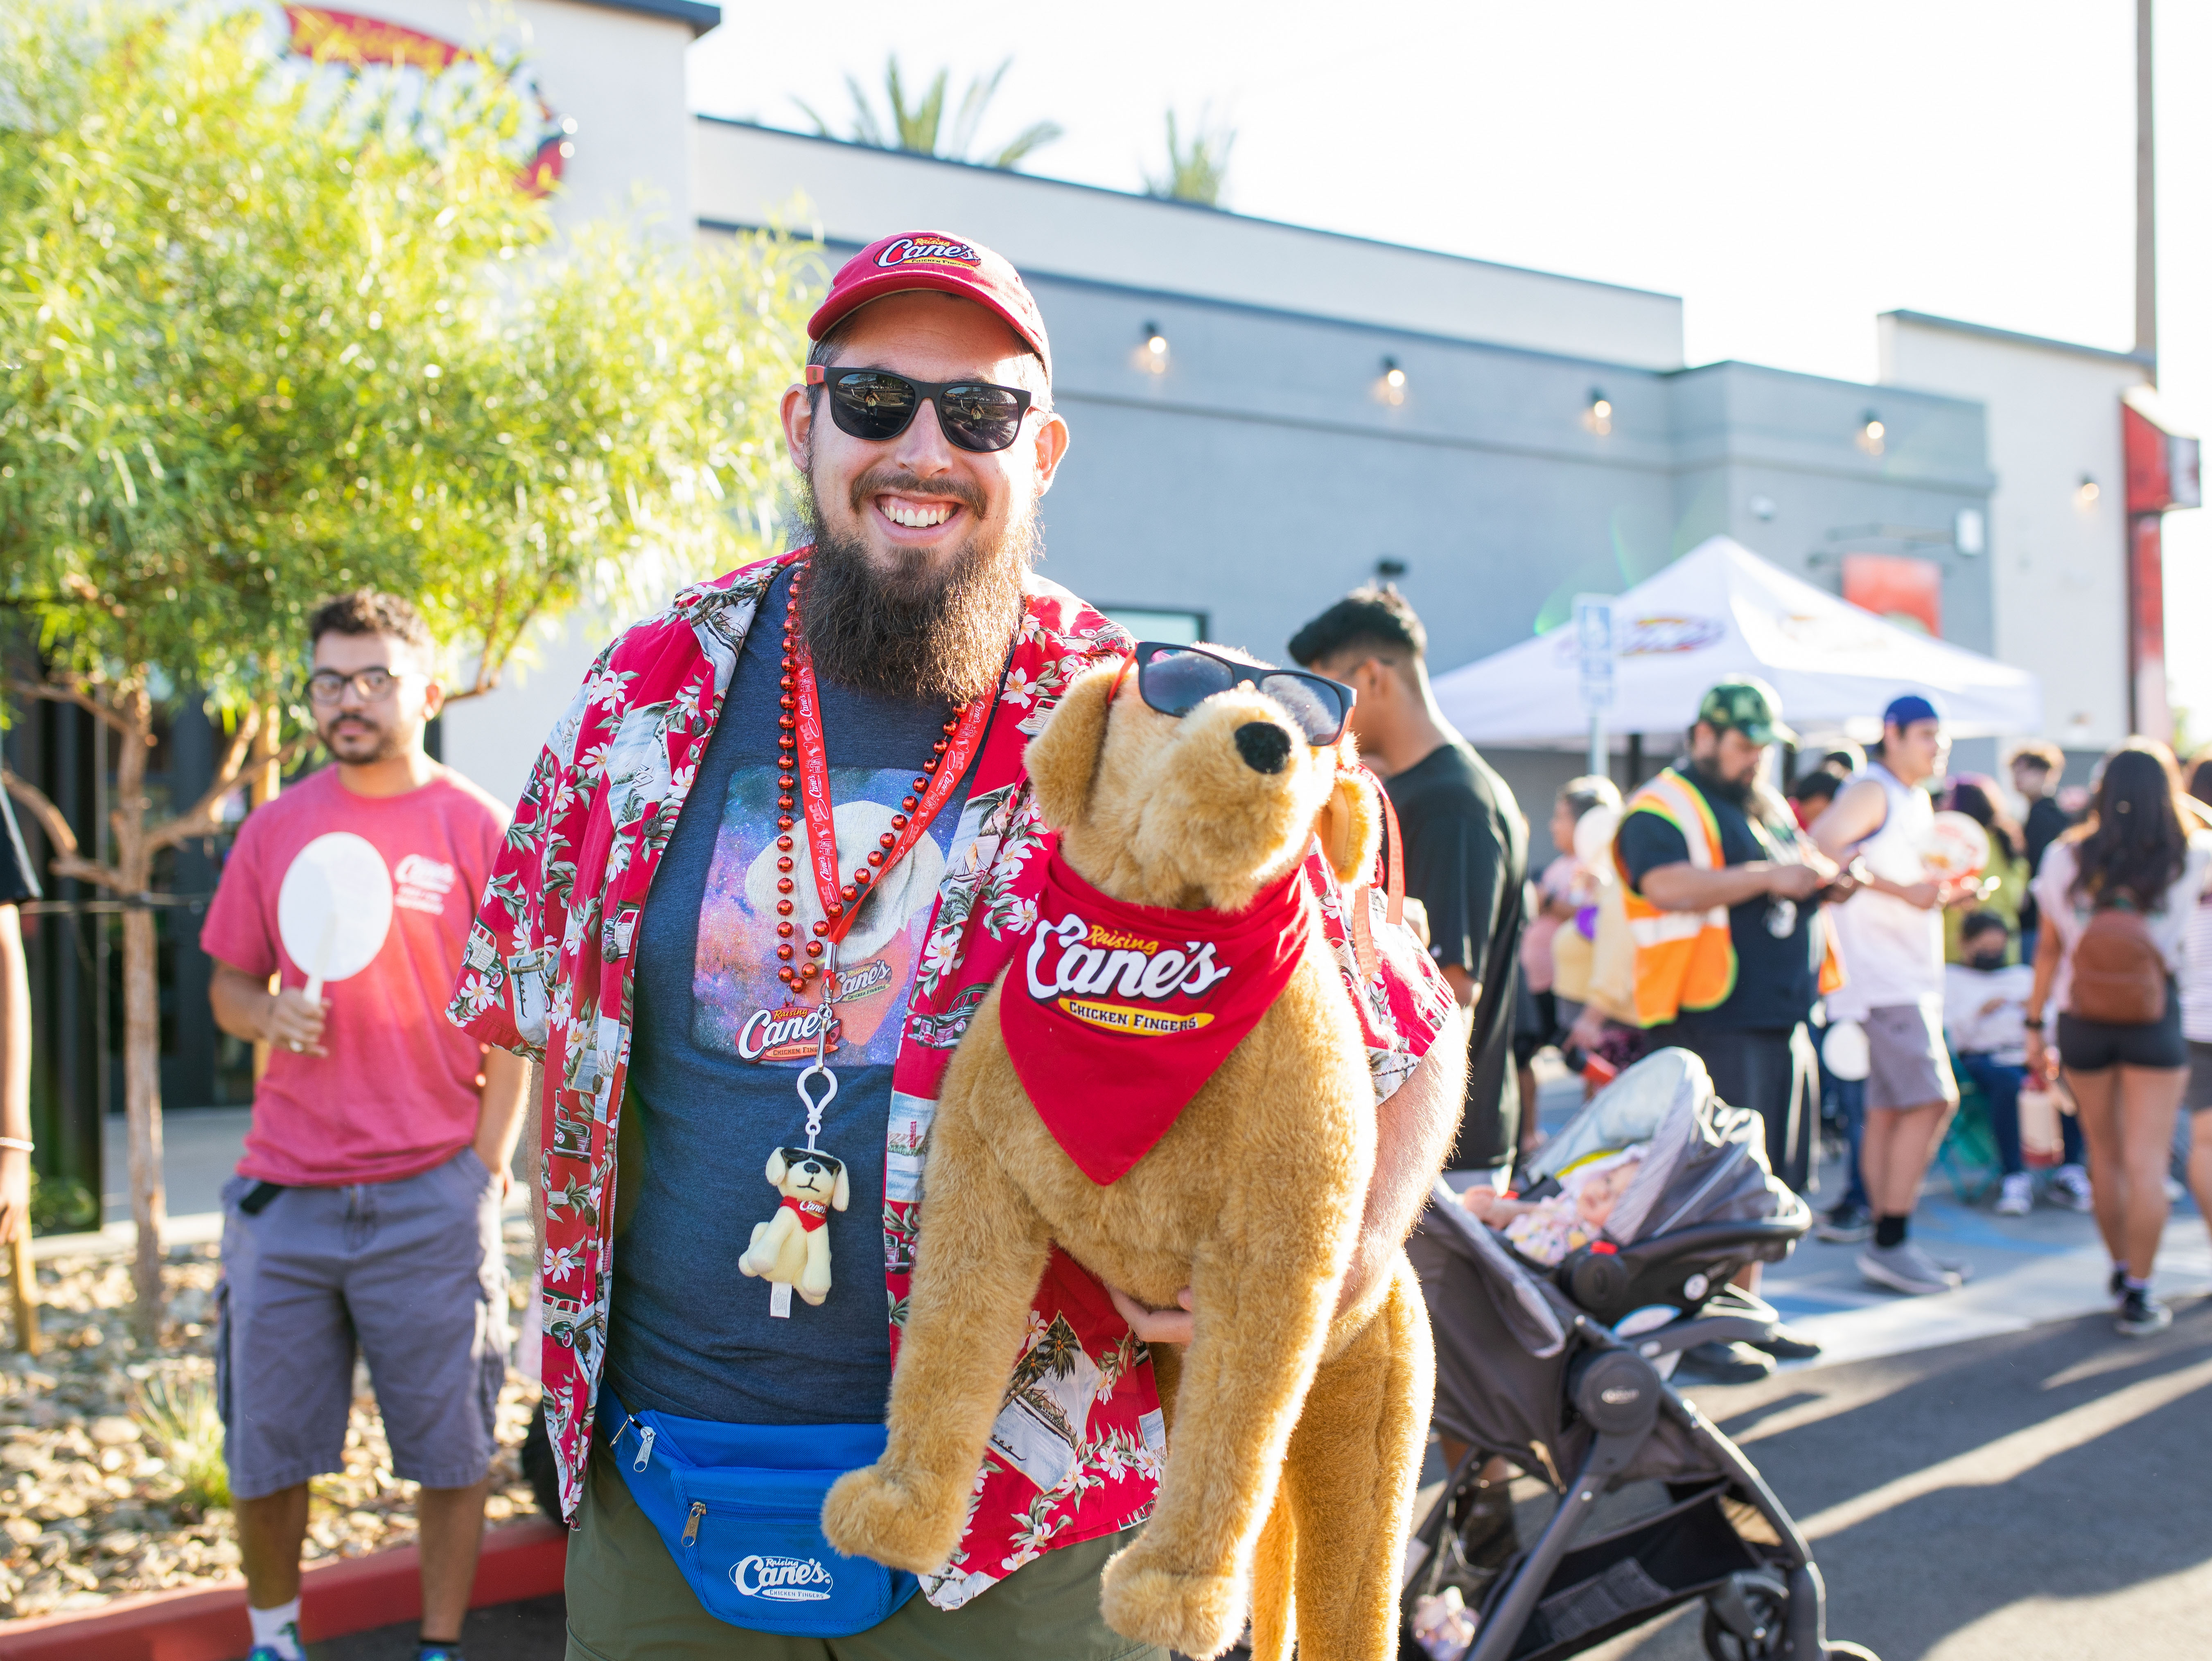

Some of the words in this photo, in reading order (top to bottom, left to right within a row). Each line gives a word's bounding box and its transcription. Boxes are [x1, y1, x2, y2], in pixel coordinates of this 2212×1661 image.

[878, 239, 980, 267] Cane's
[914, 238, 950, 247] Raising
[799, 695, 812, 717] Cane's
[808, 775, 822, 798] Cane's
[940, 771, 954, 796] Cane's
[818, 856, 832, 881] Cane's
[1083, 924, 1159, 956] Raising
[1354, 890, 1375, 969] RAISIN
[1027, 913, 1232, 999] Cane's
[822, 959, 891, 1004] Cane's
[847, 966, 871, 977] Raising
[773, 1008, 808, 1021] Raising
[1069, 1001, 1129, 1026] CHICKEN
[1133, 1014, 1199, 1032] FINGERS
[773, 1048, 801, 1056] CHICKEN
[802, 1045, 831, 1054] FINGS
[799, 1200, 826, 1214] Cane's
[765, 1558, 799, 1568] Raising
[735, 1555, 831, 1596] Cane's
[798, 1591, 824, 1599] FINGERS
